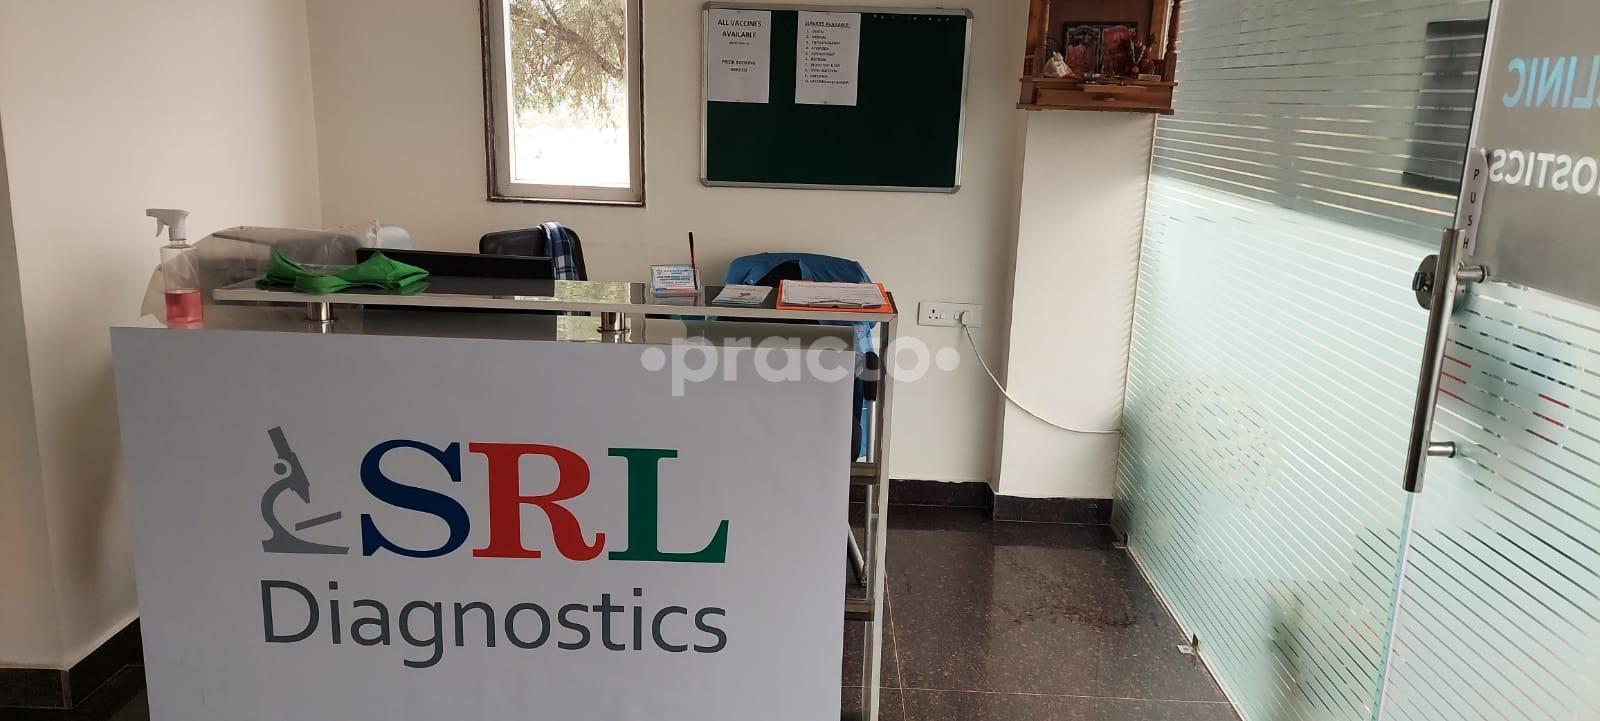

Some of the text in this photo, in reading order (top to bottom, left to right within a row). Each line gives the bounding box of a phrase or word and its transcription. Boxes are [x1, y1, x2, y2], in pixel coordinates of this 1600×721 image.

[722, 30, 757, 38] AVAILABLE
[1462, 168, 1480, 249] PUSH
[360, 439, 729, 564] SRL
[261, 580, 727, 668] Diagnostics
